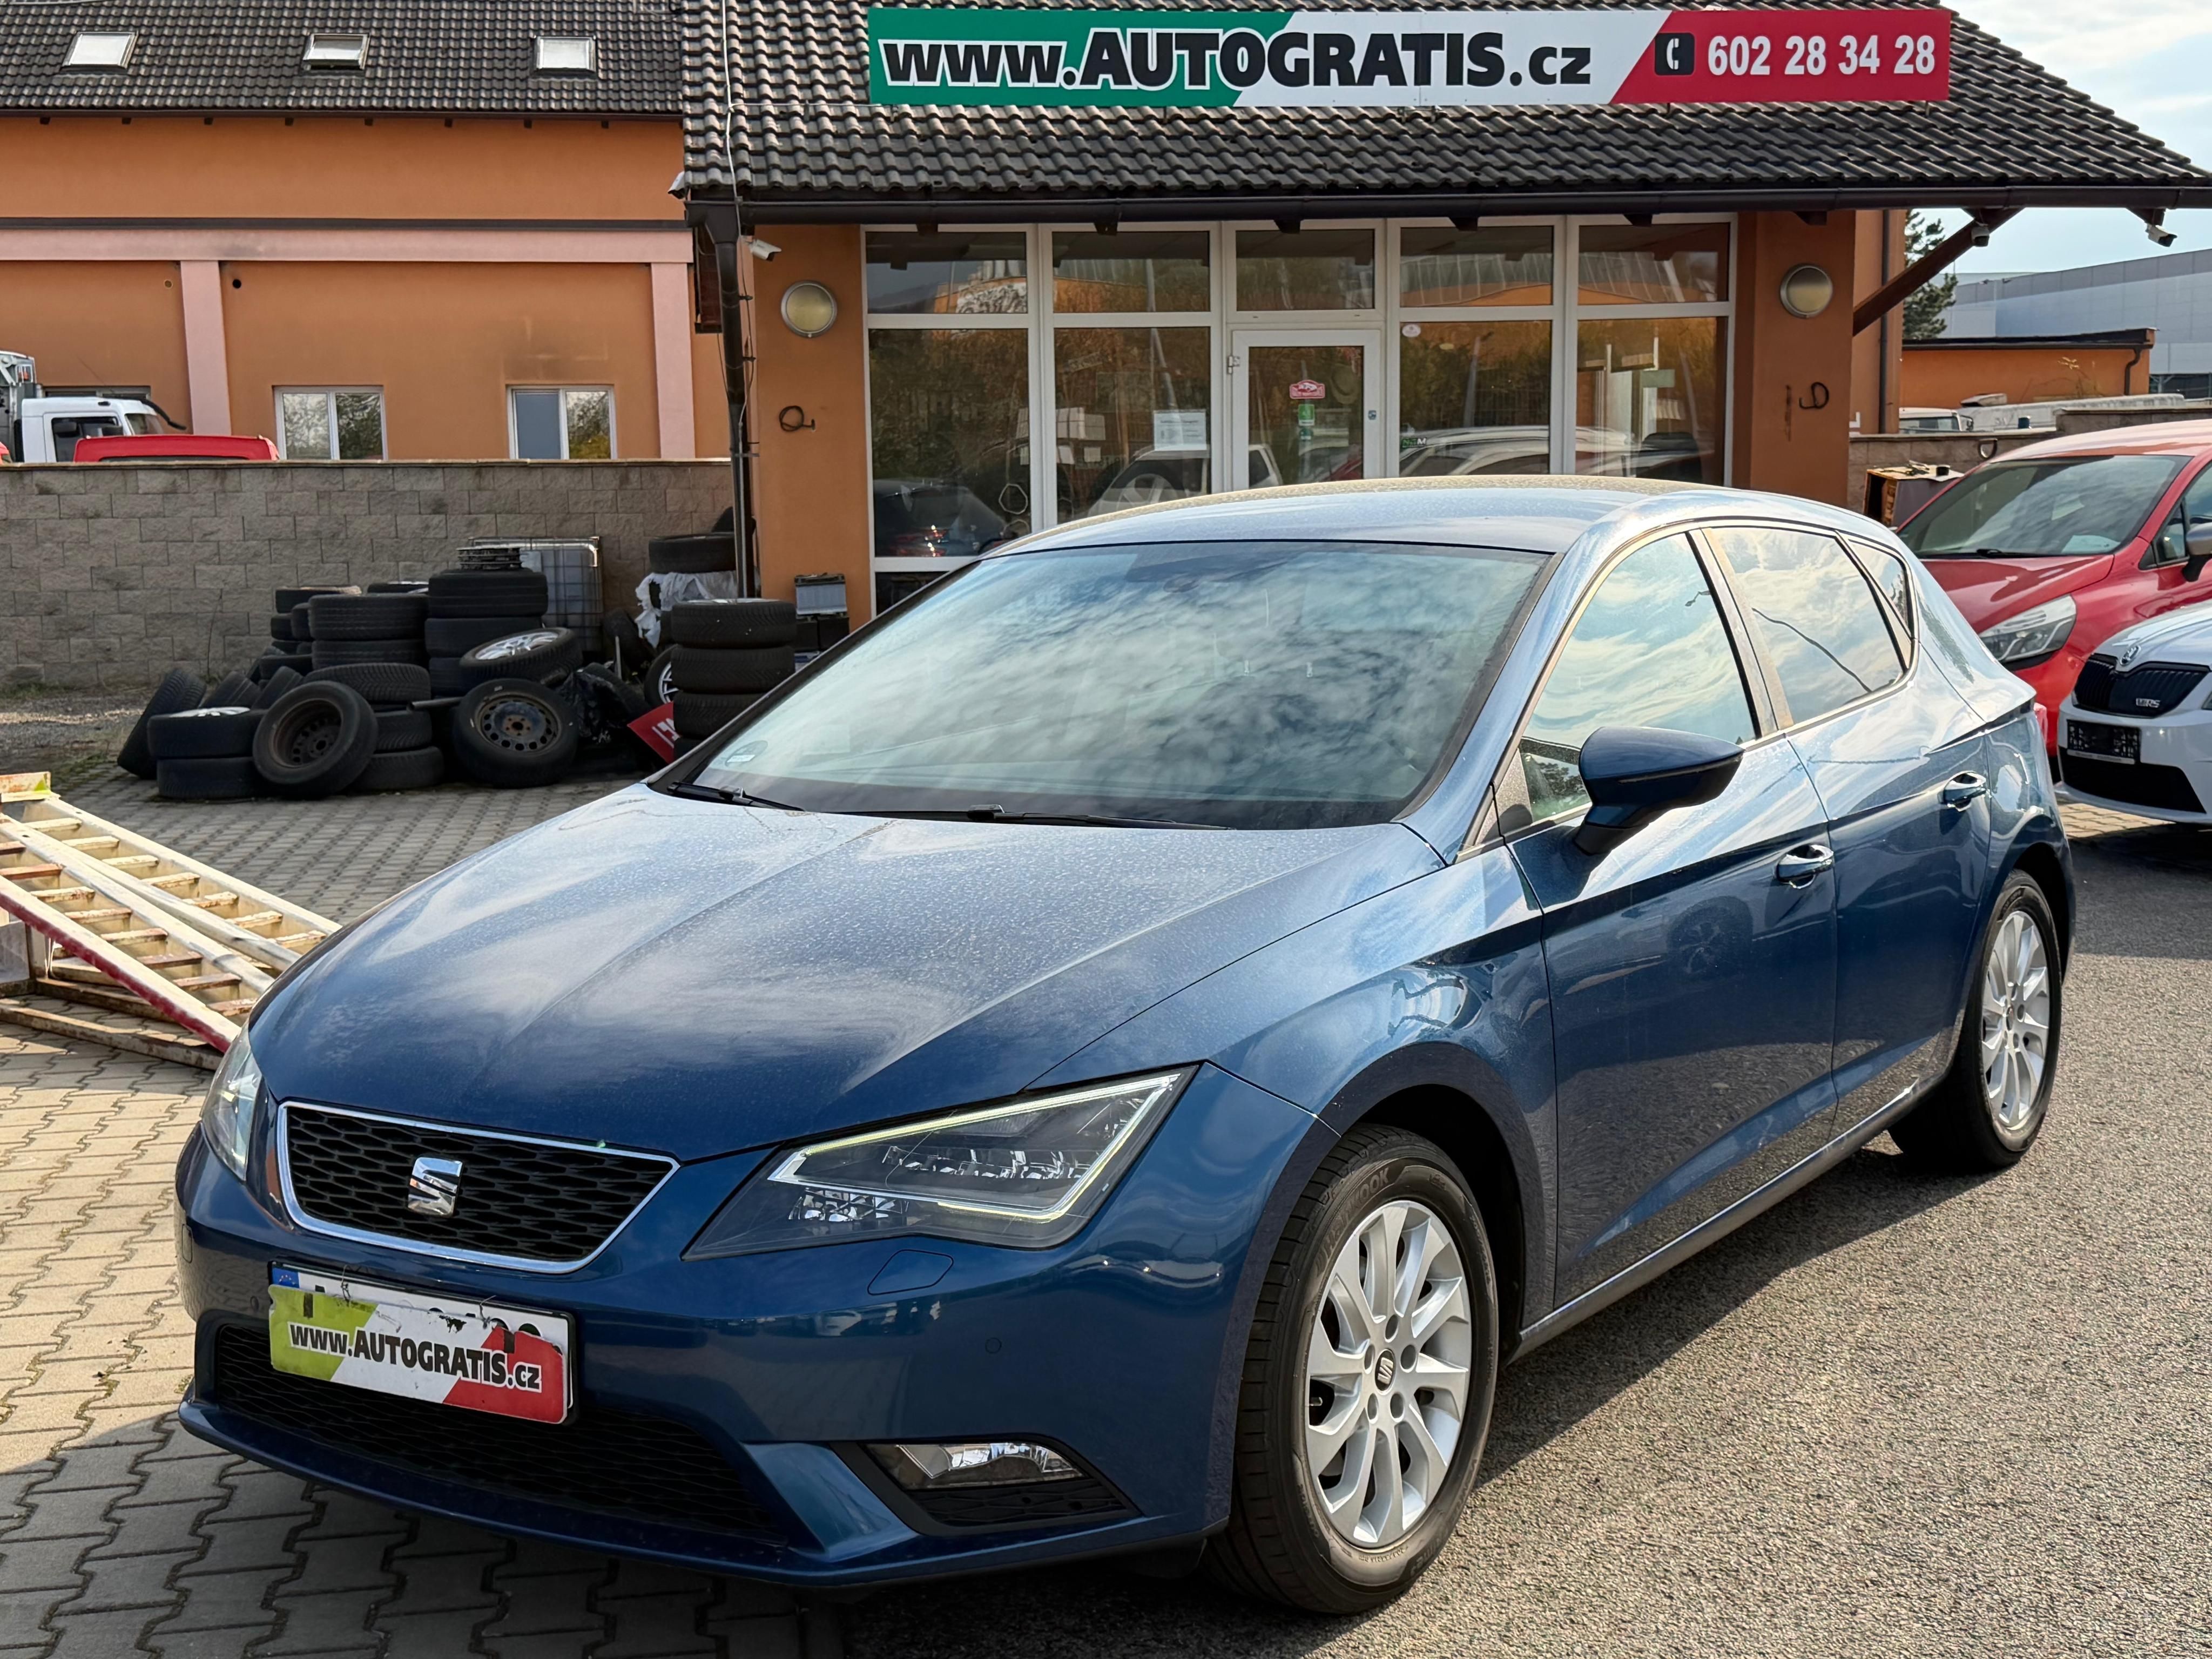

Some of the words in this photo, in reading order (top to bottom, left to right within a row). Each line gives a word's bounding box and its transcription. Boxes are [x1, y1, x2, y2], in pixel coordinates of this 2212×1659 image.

[882, 31, 1591, 88] www.AUTOGRATIS.cz
[1708, 36, 1770, 75] 602
[1784, 36, 1826, 75] 28
[1839, 35, 1879, 74] 34
[1894, 35, 1934, 74] 28
[289, 1323, 541, 1391] www.AUTOGRATIS.cz
